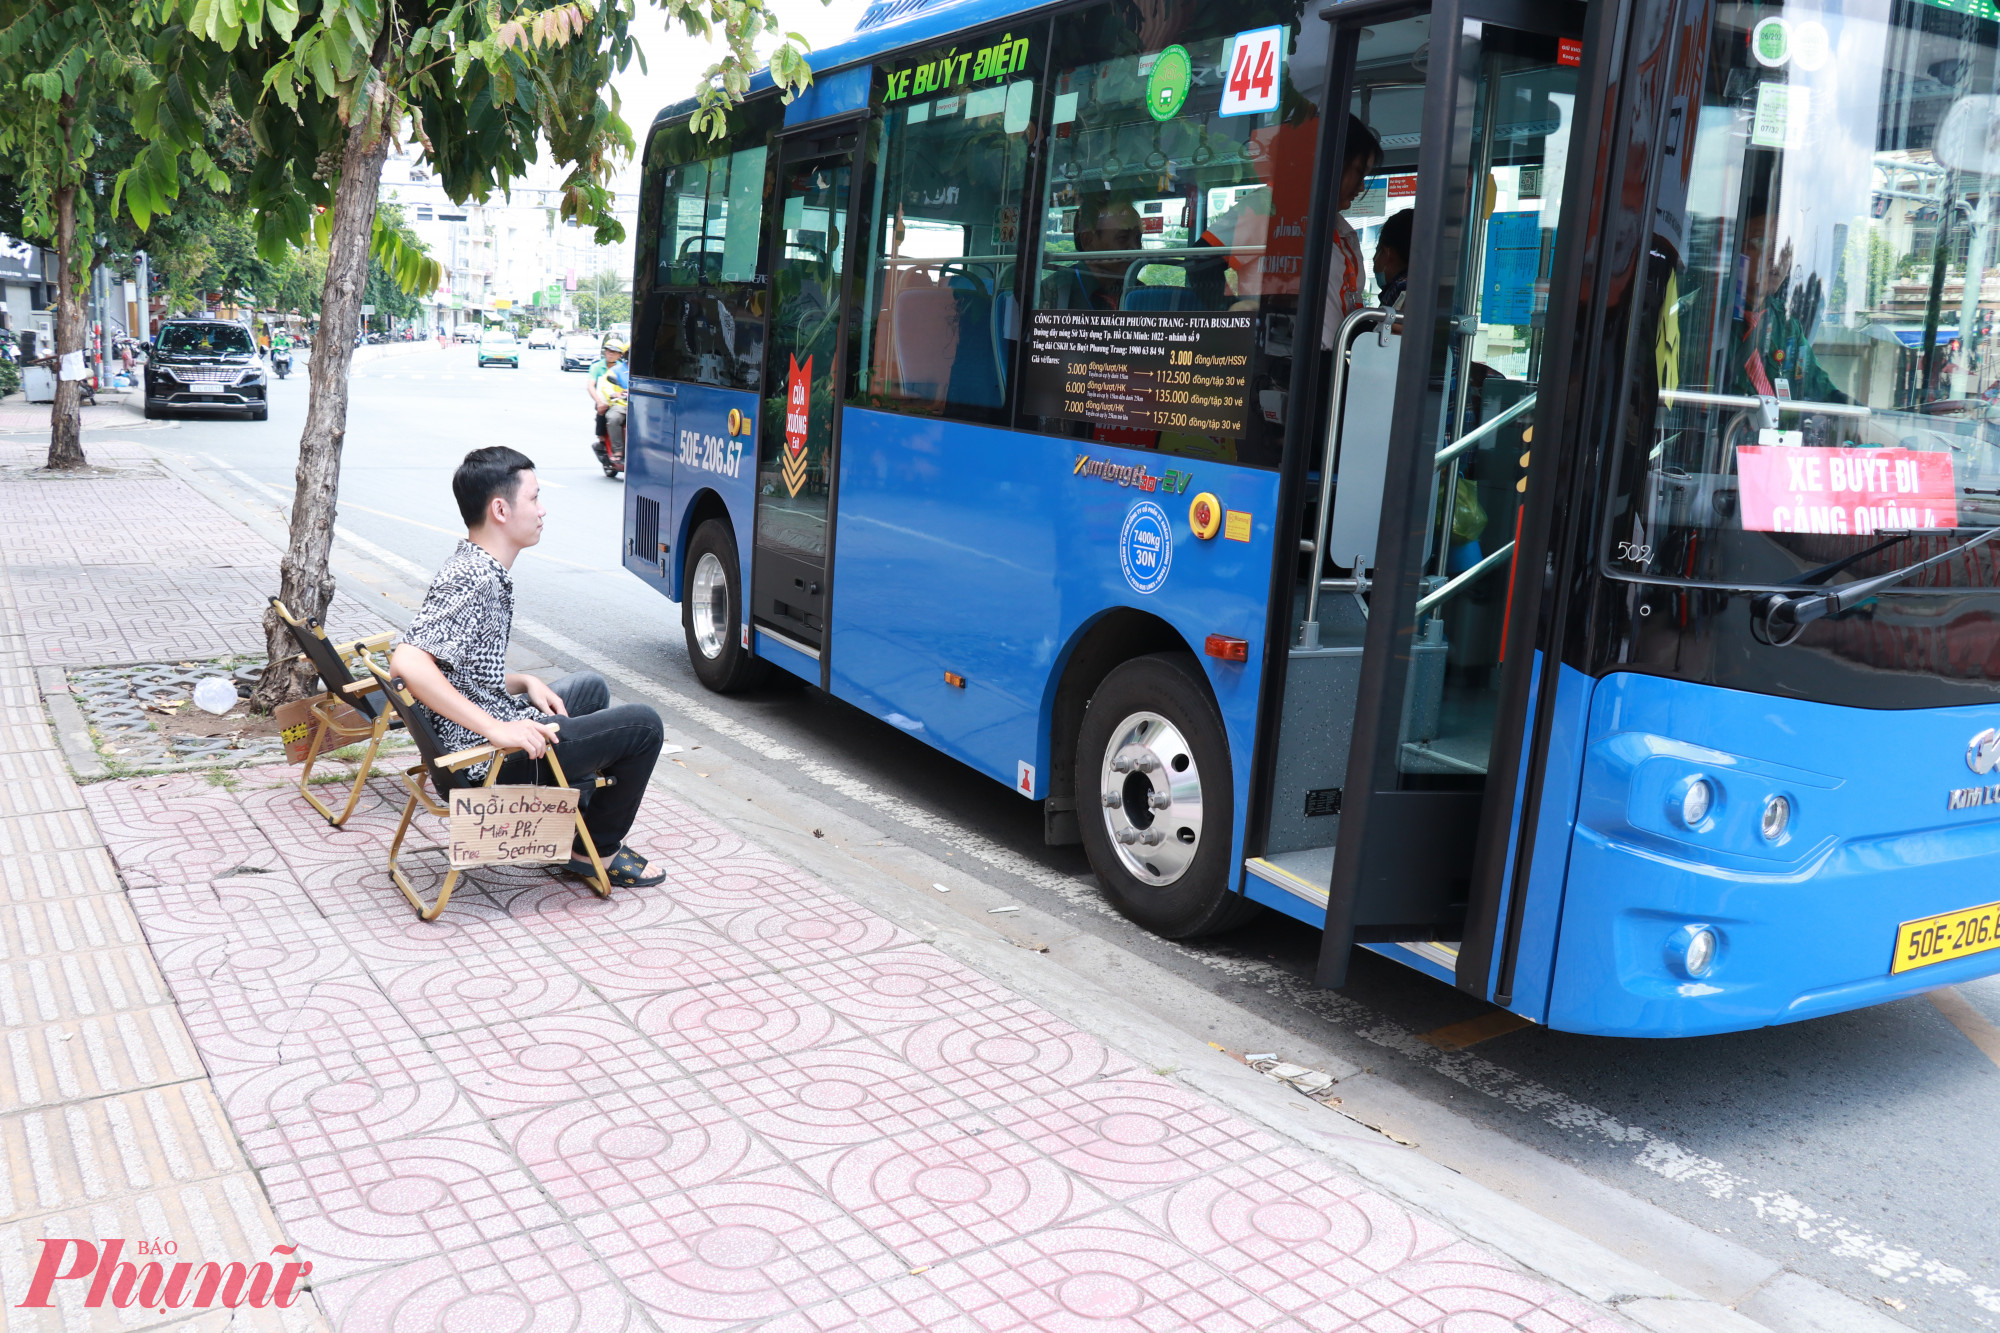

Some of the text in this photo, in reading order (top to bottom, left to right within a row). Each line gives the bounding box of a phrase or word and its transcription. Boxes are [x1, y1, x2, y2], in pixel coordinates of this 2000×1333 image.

[882, 32, 1029, 103] XE BUÝT ĐIỆN
[1229, 40, 1274, 101] 44
[1034, 313, 1052, 324] CÔNG
[1053, 315, 1061, 324] TY
[1061, 313, 1071, 324] CỔ
[1072, 314, 1089, 325] PHẦN
[1090, 316, 1100, 325] XE
[1100, 314, 1125, 326] KHÁCH
[1126, 316, 1157, 327] PHƯƠNG
[1159, 318, 1184, 327] TRANG
[1189, 318, 1209, 328] FUTA
[1211, 318, 1251, 328] BUSLINES
[1033, 328, 1049, 339] Đường
[1049, 329, 1058, 338] dây
[1059, 330, 1070, 339] nóng
[1071, 329, 1078, 337] Sở
[1079, 329, 1088, 339] Xây
[1089, 330, 1103, 340] dựng
[1104, 331, 1112, 341] Tp.
[1113, 329, 1121, 339] Hồ
[1122, 331, 1132, 340] Chí
[1133, 332, 1149, 340] Minh:
[1151, 332, 1164, 340] 1022
[1169, 333, 1187, 341] nhánh
[1188, 331, 1195, 342] số
[1196, 333, 1200, 342] 9
[1031, 354, 1040, 363] Giá
[1033, 339, 1044, 351] Tổng
[1053, 342, 1069, 351] CSKH
[1069, 343, 1076, 351] Xe
[1077, 343, 1089, 353] Buýt
[1089, 344, 1109, 355] Phương
[1110, 345, 1128, 356] Trang:
[1129, 346, 1141, 354] 1900
[1142, 347, 1149, 355] 63
[1149, 347, 1157, 355] 84
[1158, 347, 1165, 355] 94
[1169, 350, 1247, 367] 3.000 đồng/lượt/HSSV
[1067, 361, 1245, 387] 5.000 đồng/lượt/HK 112.500 đồng/tập 30 vé
[792, 379, 805, 406] CỬA
[1065, 380, 1243, 407] 6.000 đồng/lượt/HK 135.000 đồng/tập 30 vé
[786, 407, 807, 435] XUỐNG
[1064, 400, 1241, 430] 7.000 đồng/lượt/HK 157.500 đồng/tập 30 vé
[679, 429, 743, 479] 50E-206.67
[792, 437, 800, 450] Exit
[1786, 452, 1919, 494] XE BUÝT ĐI
[1772, 494, 1848, 534] CẢNG
[1133, 529, 1160, 549] 7400kg
[1135, 549, 1156, 568] 30N
[1617, 541, 1654, 565] 502
[456, 794, 577, 826] Ngồi chờ xe Bus
[1947, 787, 1983, 811] KIM
[480, 817, 544, 840] Miễn Phí
[453, 839, 558, 862] Free Seating
